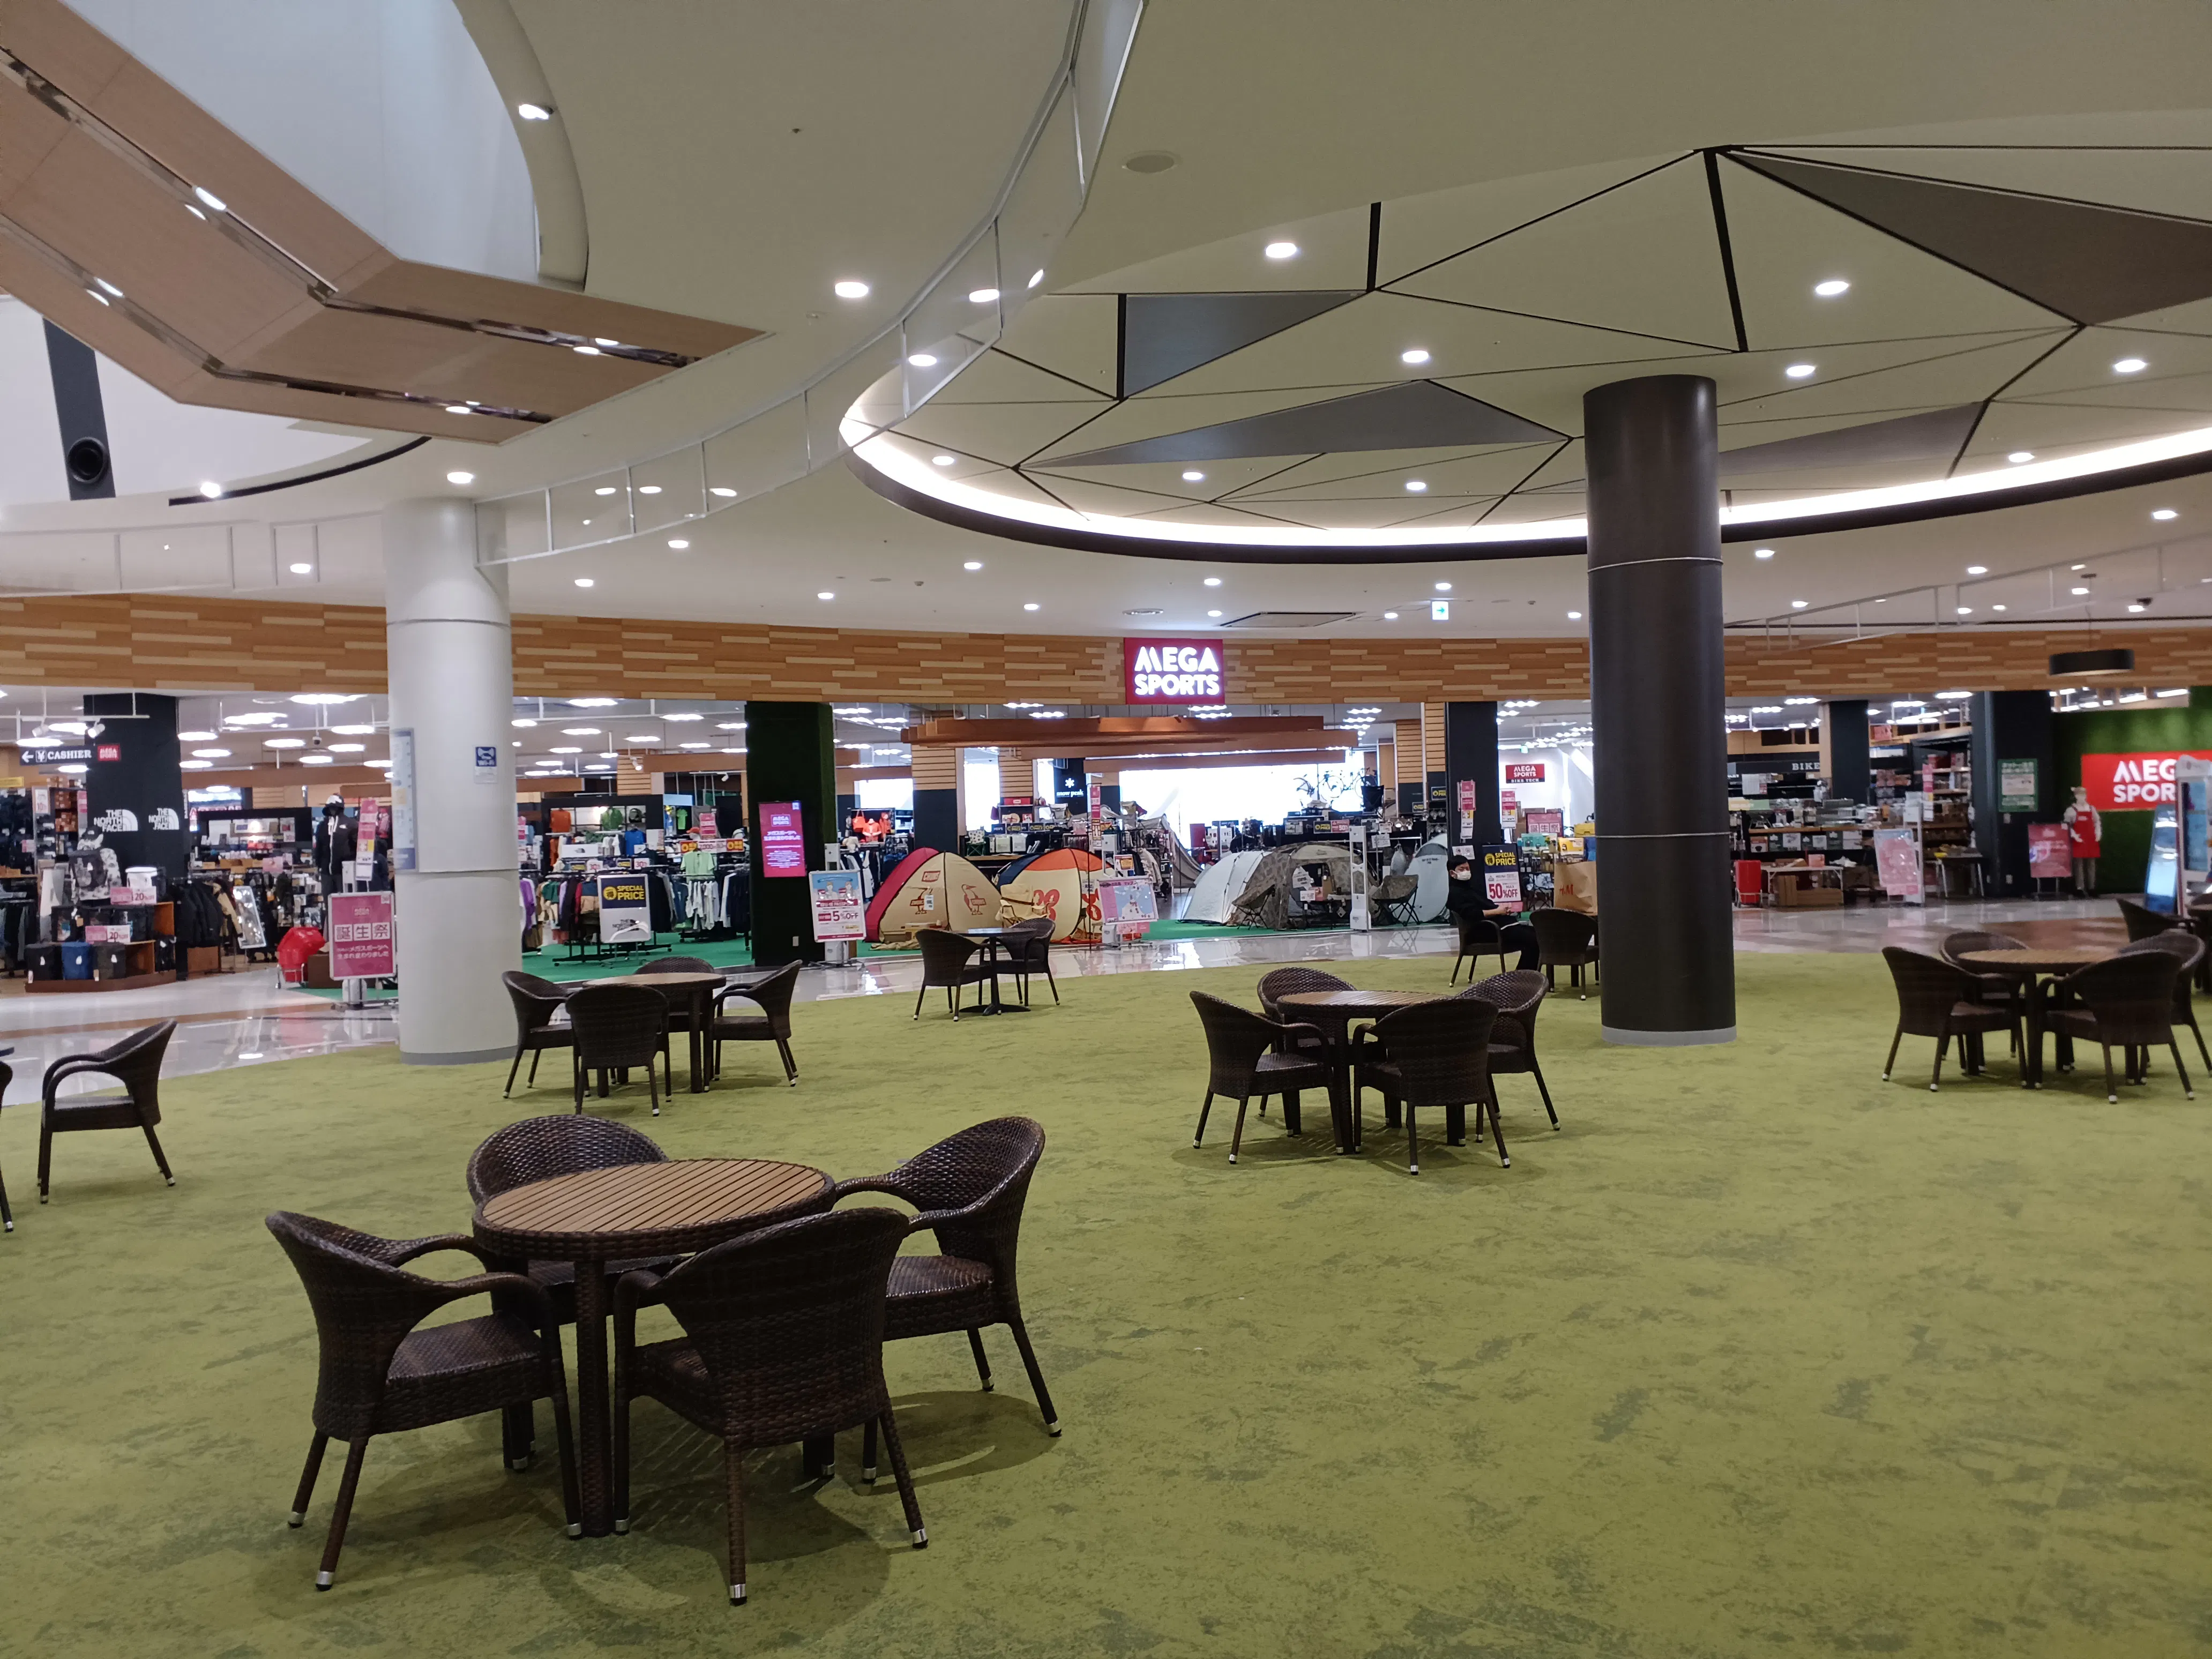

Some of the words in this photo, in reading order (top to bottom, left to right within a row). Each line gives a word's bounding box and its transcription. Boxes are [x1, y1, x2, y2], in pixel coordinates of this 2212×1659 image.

[1134, 646, 1219, 673] MEGA
[1134, 674, 1220, 696] SPORTS
[47, 750, 92, 760] CASHIER
[1791, 762, 1820, 771] BIKE
[1071, 789, 1084, 797] peak
[106, 809, 122, 817] THE
[94, 817, 123, 827] NORTH
[148, 815, 169, 823] NORTH
[1496, 858, 1516, 866] PRICE
[617, 891, 645, 900] PRICE
[337, 924, 388, 940] 誕生祭
